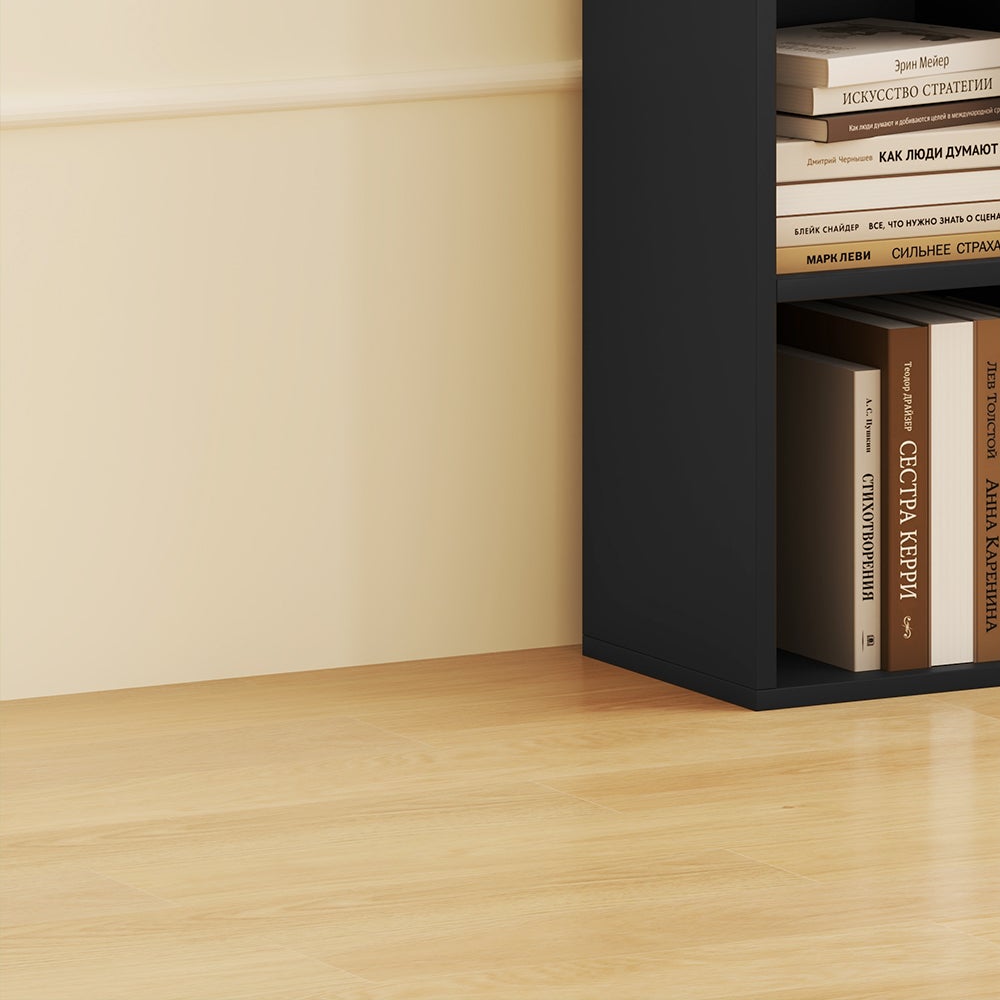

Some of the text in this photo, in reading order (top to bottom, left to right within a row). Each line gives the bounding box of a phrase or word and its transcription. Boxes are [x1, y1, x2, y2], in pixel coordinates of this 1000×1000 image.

[895, 54, 949, 73] Эрин Мейер
[842, 78, 993, 106] ИСКУССТВО СТРАТЕГИИ
[807, 143, 998, 167] Дмитрий Чернышев КАК ЛЮДИ ДУМАЮТ
[794, 226, 820, 235] БЛЕЙК
[823, 223, 860, 234] СНАЙДЕР
[869, 220, 886, 231] ВСЕ,
[888, 219, 904, 228] ЧТО
[905, 217, 938, 227] НУЖНО
[939, 214, 965, 225] ЗНАТЬ
[966, 214, 973, 223] О
[806, 253, 838, 265] МАРК
[839, 251, 871, 262] ЛЕВИ
[892, 243, 951, 259] СИЛЬНЕЕ
[902, 361, 913, 432] Теодор ДРАЙЗЕР
[864, 418, 873, 453] Пушкин
[899, 440, 917, 600] СЕСТРА КЕРРИ
[862, 473, 874, 601] СТИХОТВОРЕНИЯ
